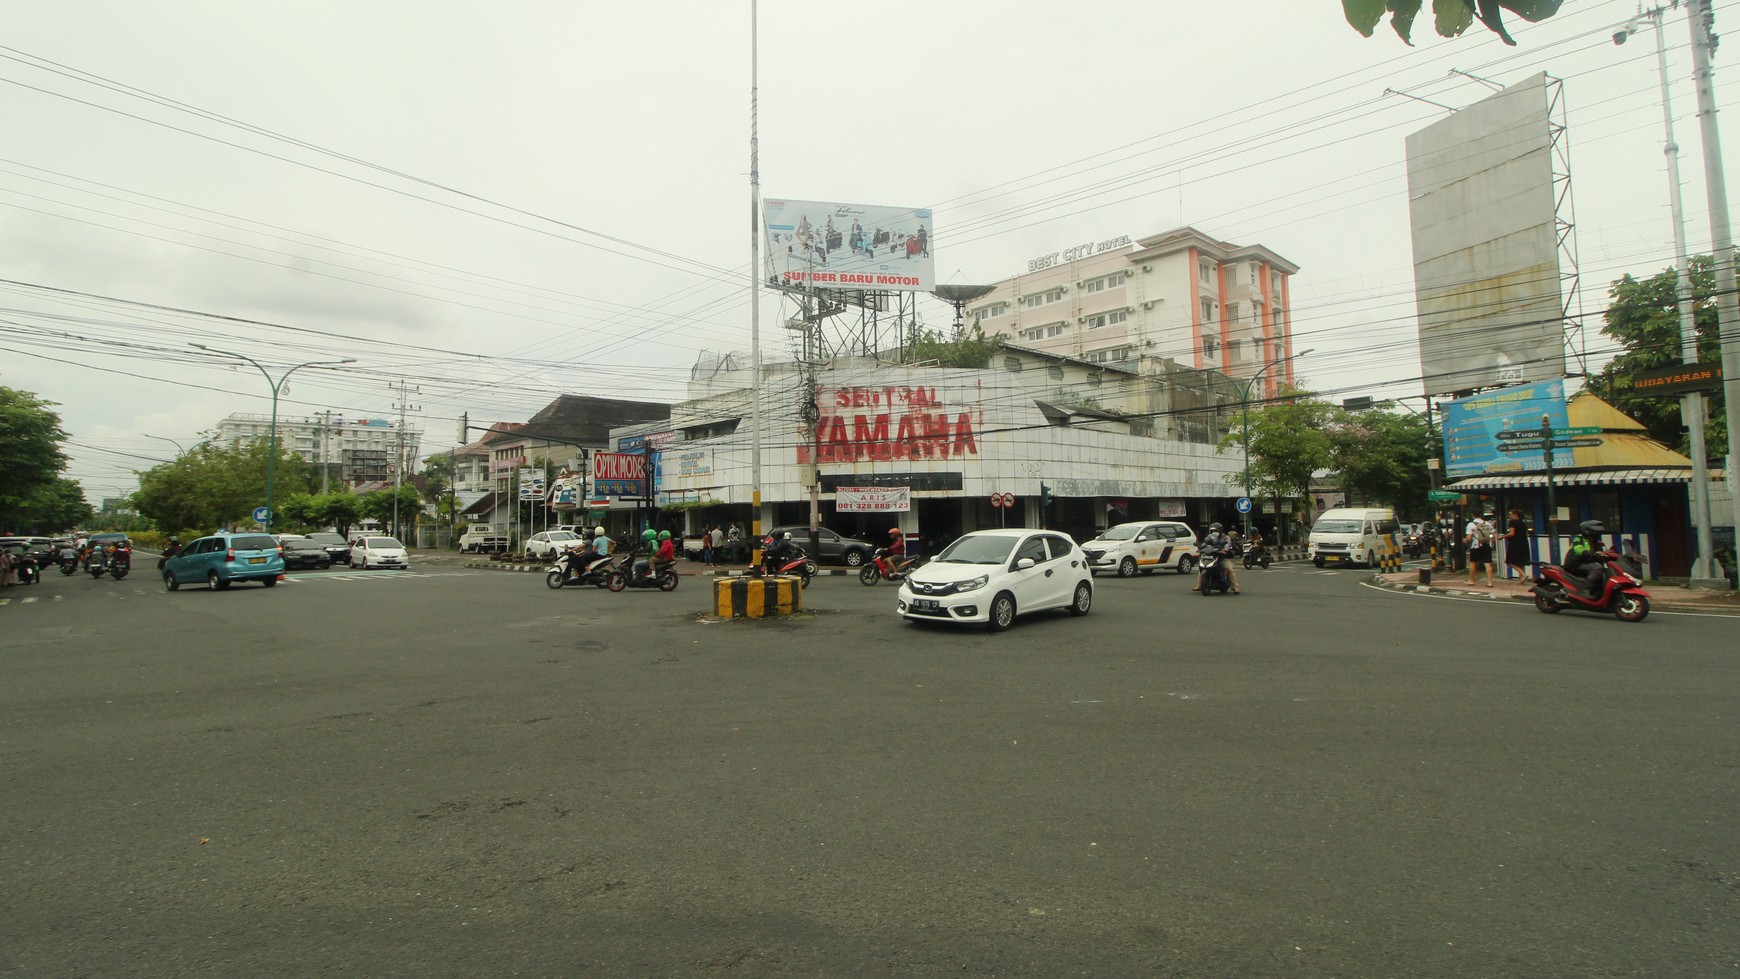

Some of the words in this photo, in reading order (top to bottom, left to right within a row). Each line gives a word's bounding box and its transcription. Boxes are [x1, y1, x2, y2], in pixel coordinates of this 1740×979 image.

[1028, 253, 1059, 271] BEST
[1063, 242, 1094, 261] CITY
[1097, 235, 1132, 252] HOTEL
[840, 274, 873, 284] BARU
[876, 276, 920, 286] MOTOR
[595, 454, 617, 478] OPTIK
